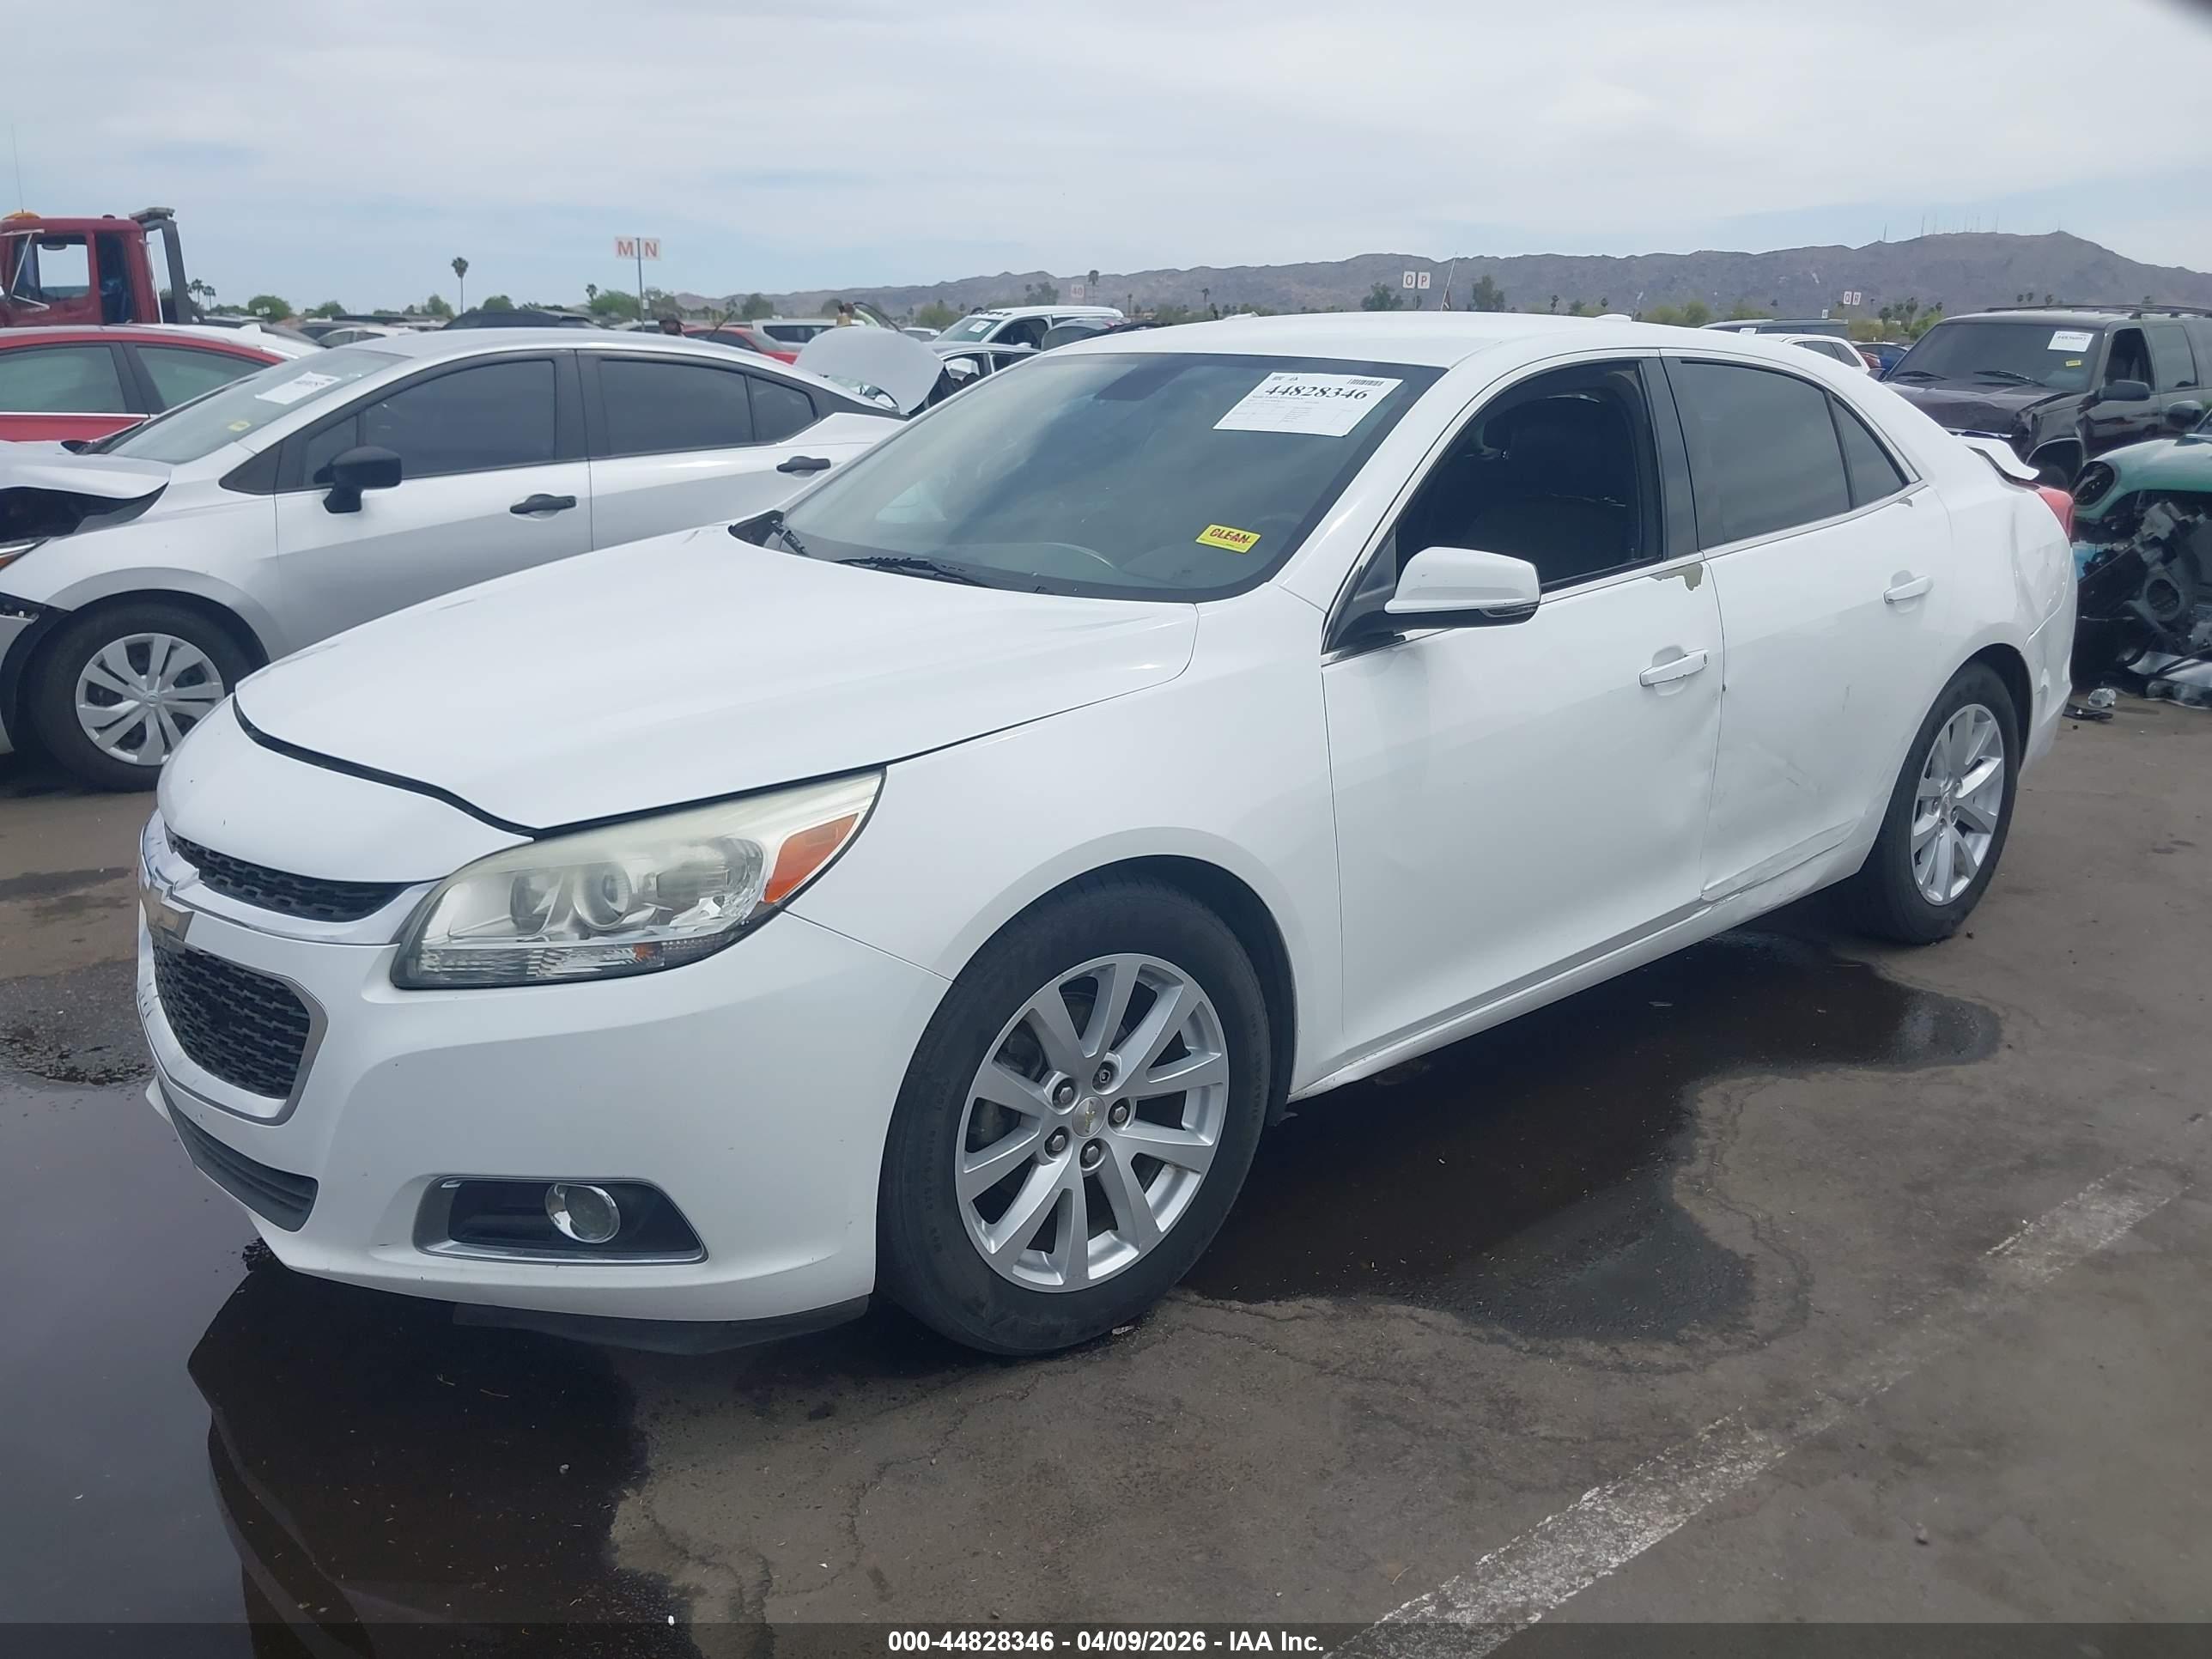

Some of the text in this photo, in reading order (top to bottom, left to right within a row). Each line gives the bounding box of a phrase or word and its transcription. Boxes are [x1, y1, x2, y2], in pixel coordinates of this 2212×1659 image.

[617, 240, 657, 257] M N
[1421, 275, 1428, 287] P
[1265, 385, 1371, 400] 44828346
[1209, 528, 1251, 544] CLEAN
